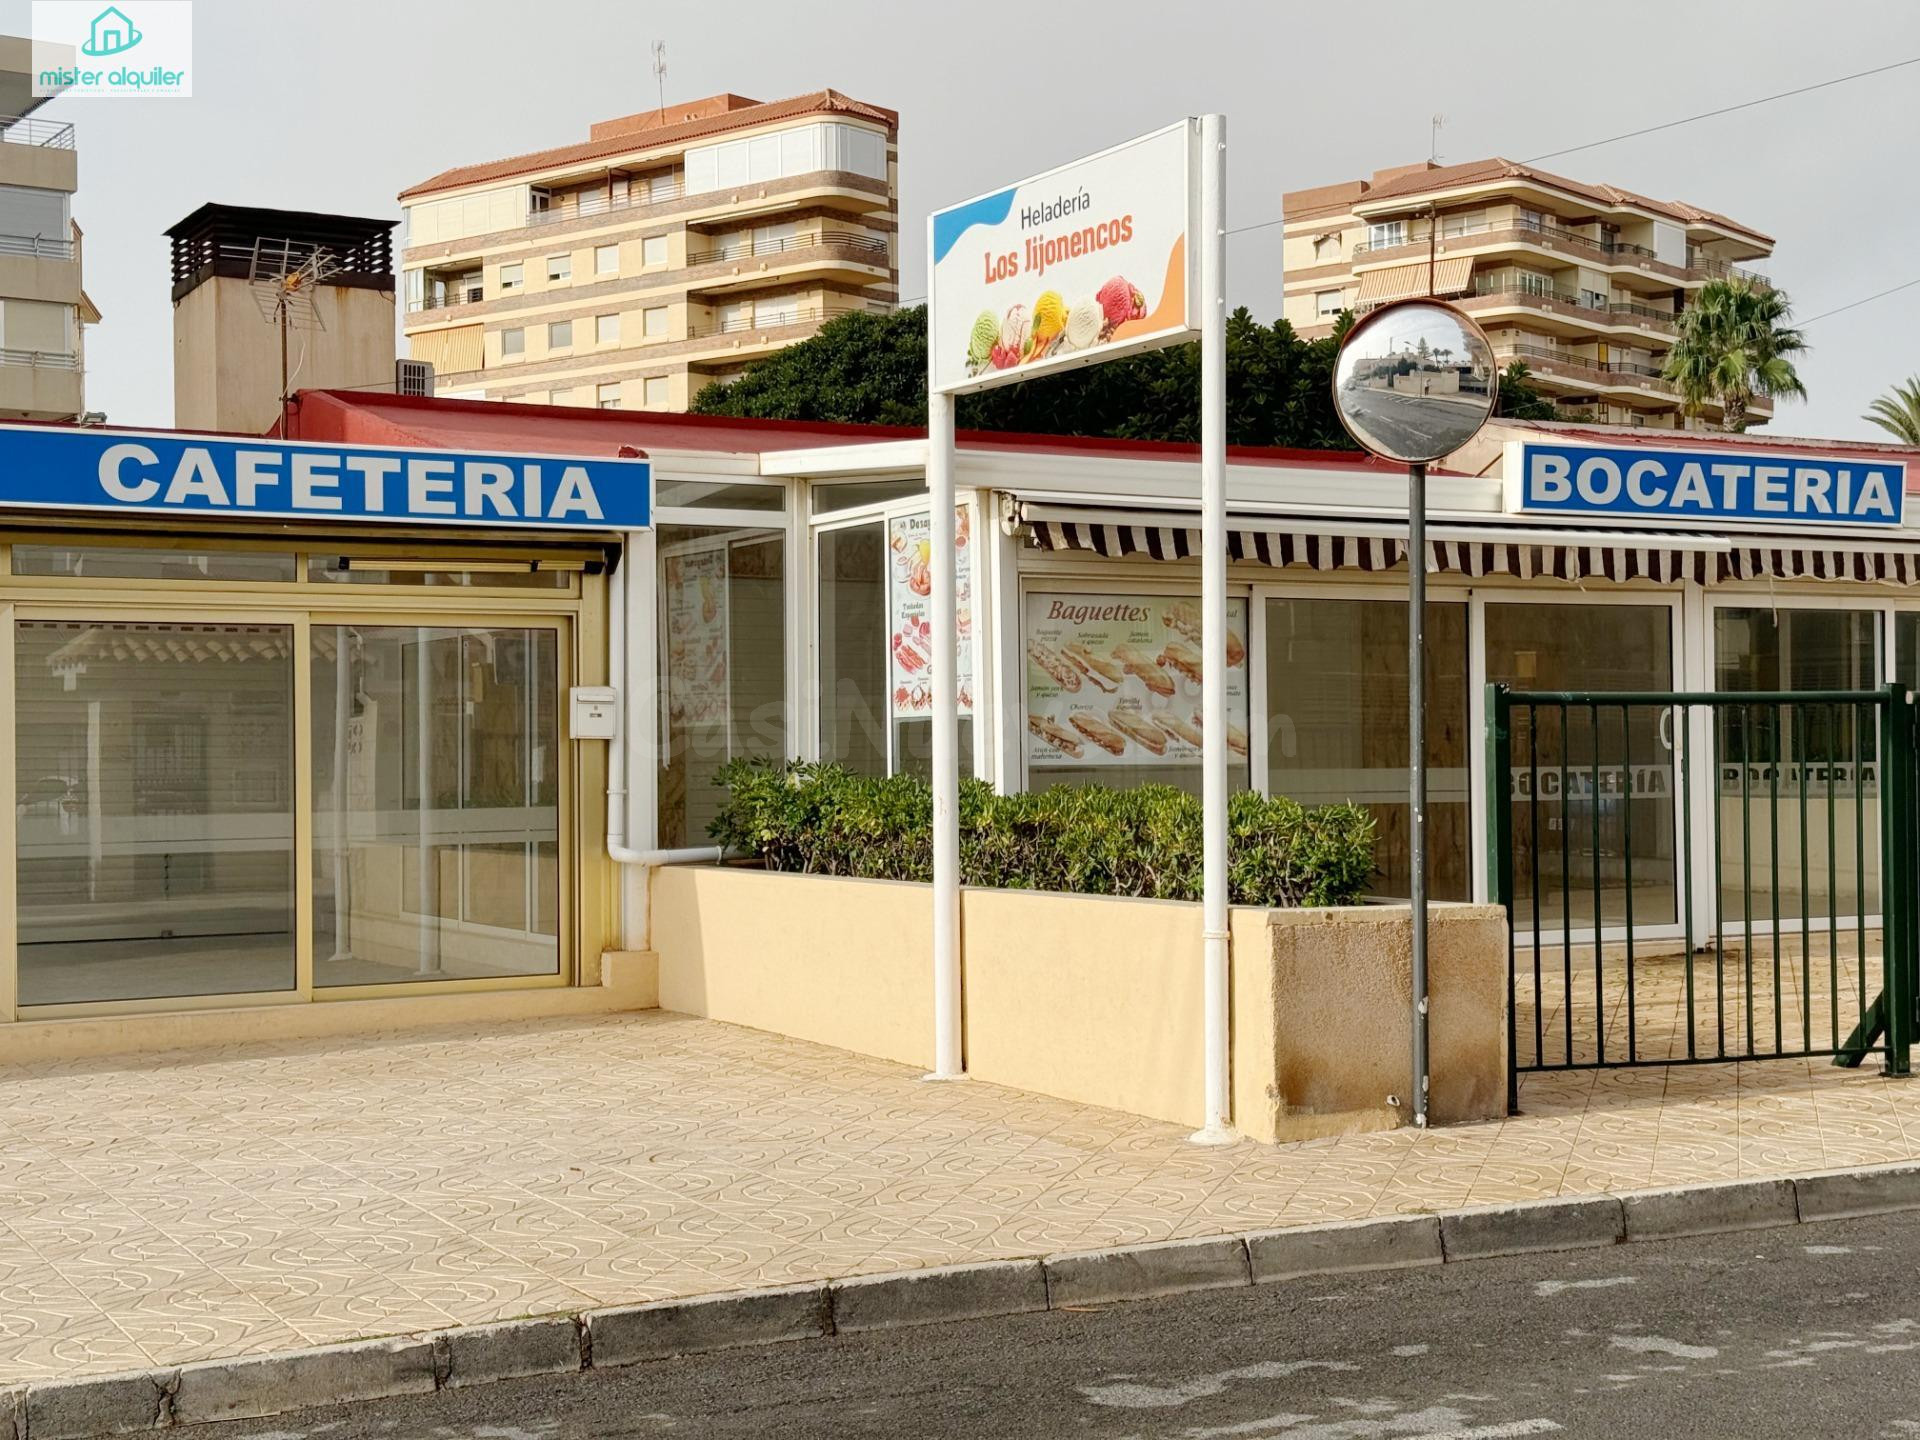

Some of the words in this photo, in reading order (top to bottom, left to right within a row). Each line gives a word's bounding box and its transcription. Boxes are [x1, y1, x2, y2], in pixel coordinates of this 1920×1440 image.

[1020, 185, 1090, 230] Heladería
[984, 251, 1018, 284] Los
[1025, 214, 1133, 277] Jijonencos
[98, 443, 605, 520] CAFETERIA
[1531, 453, 1895, 517] BOCATERIA
[1047, 600, 1151, 625] Baguettes
